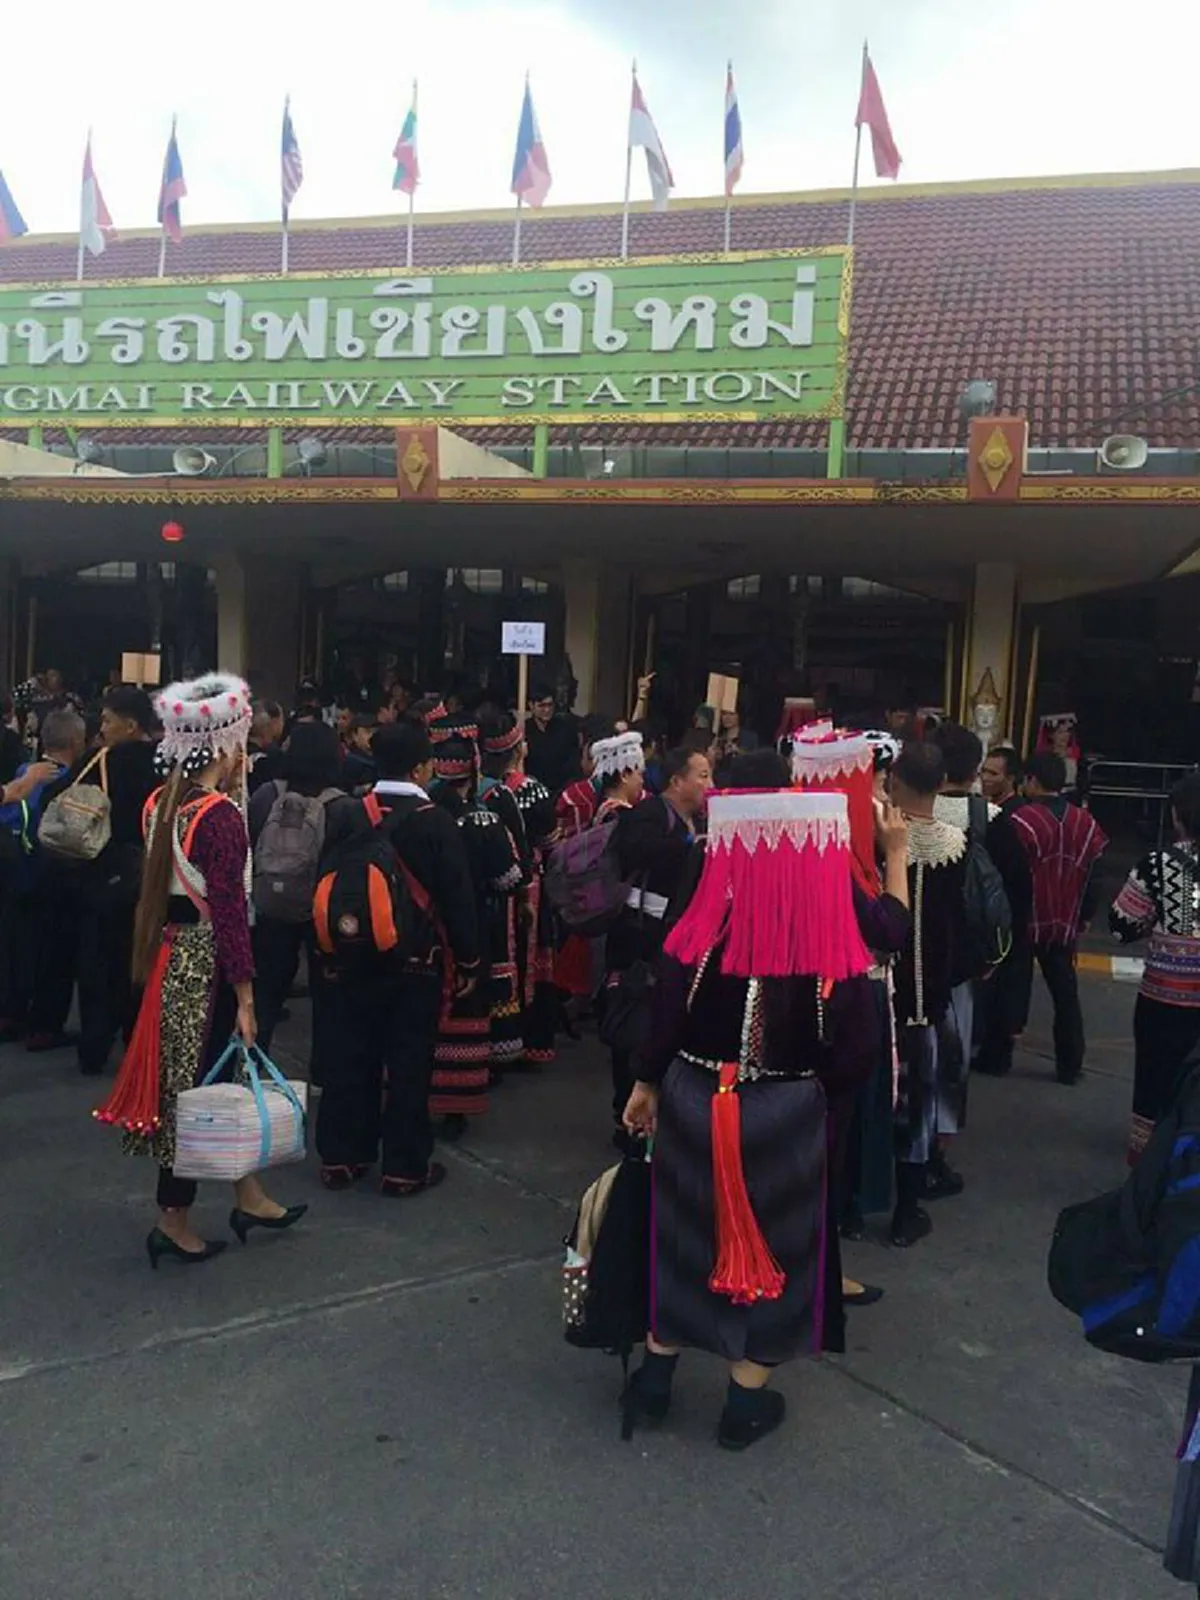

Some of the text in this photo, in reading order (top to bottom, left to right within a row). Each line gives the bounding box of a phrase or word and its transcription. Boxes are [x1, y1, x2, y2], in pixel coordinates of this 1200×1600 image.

[3, 372, 811, 412] GMAI RAILWAY STATION
